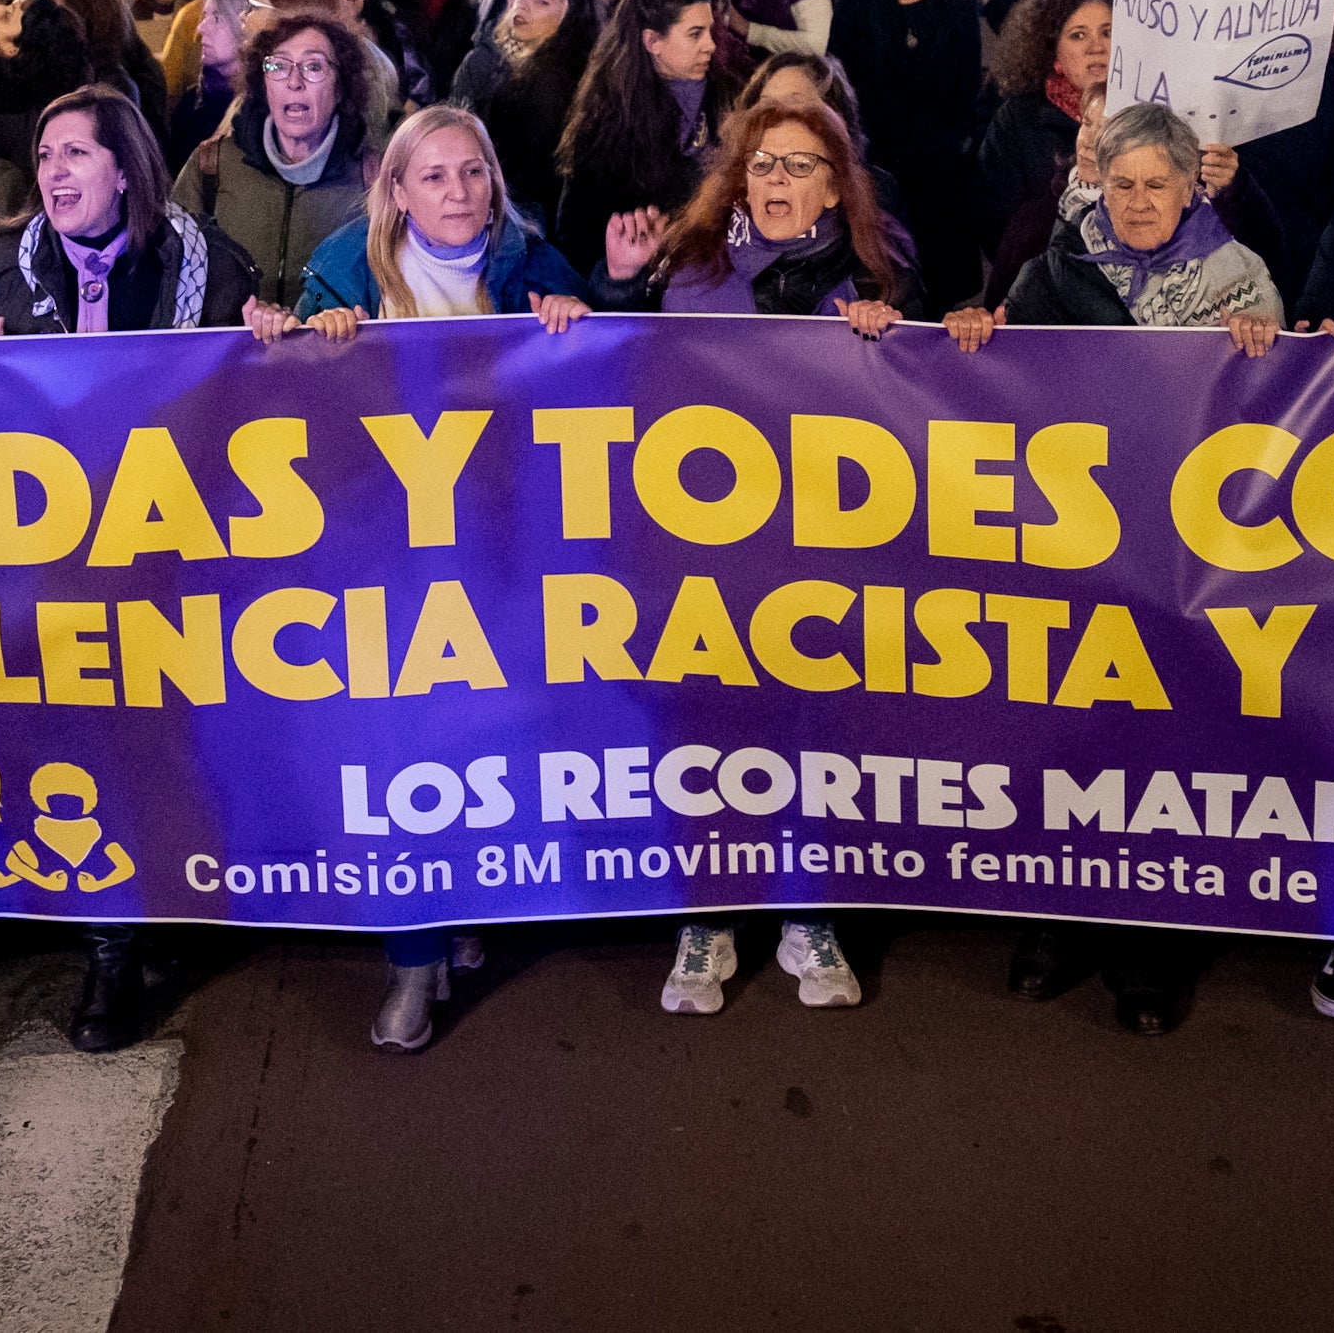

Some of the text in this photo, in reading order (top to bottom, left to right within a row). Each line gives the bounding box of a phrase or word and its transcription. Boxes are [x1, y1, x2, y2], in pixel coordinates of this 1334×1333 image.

[1189, 5, 1208, 41] Y
[1111, 46, 1123, 89] A
[1135, 61, 1170, 103] LA
[360, 410, 493, 548] Y
[532, 405, 1121, 570] TODES
[542, 573, 1173, 709] RACISTA
[1204, 603, 1317, 718] Y
[341, 756, 515, 835] LOS
[540, 745, 1017, 830] RECORTES
[185, 850, 454, 897] Comisión
[476, 841, 561, 887] 8M
[585, 830, 925, 881] movimiento
[946, 842, 1225, 897] feminista
[1249, 857, 1317, 903] de
